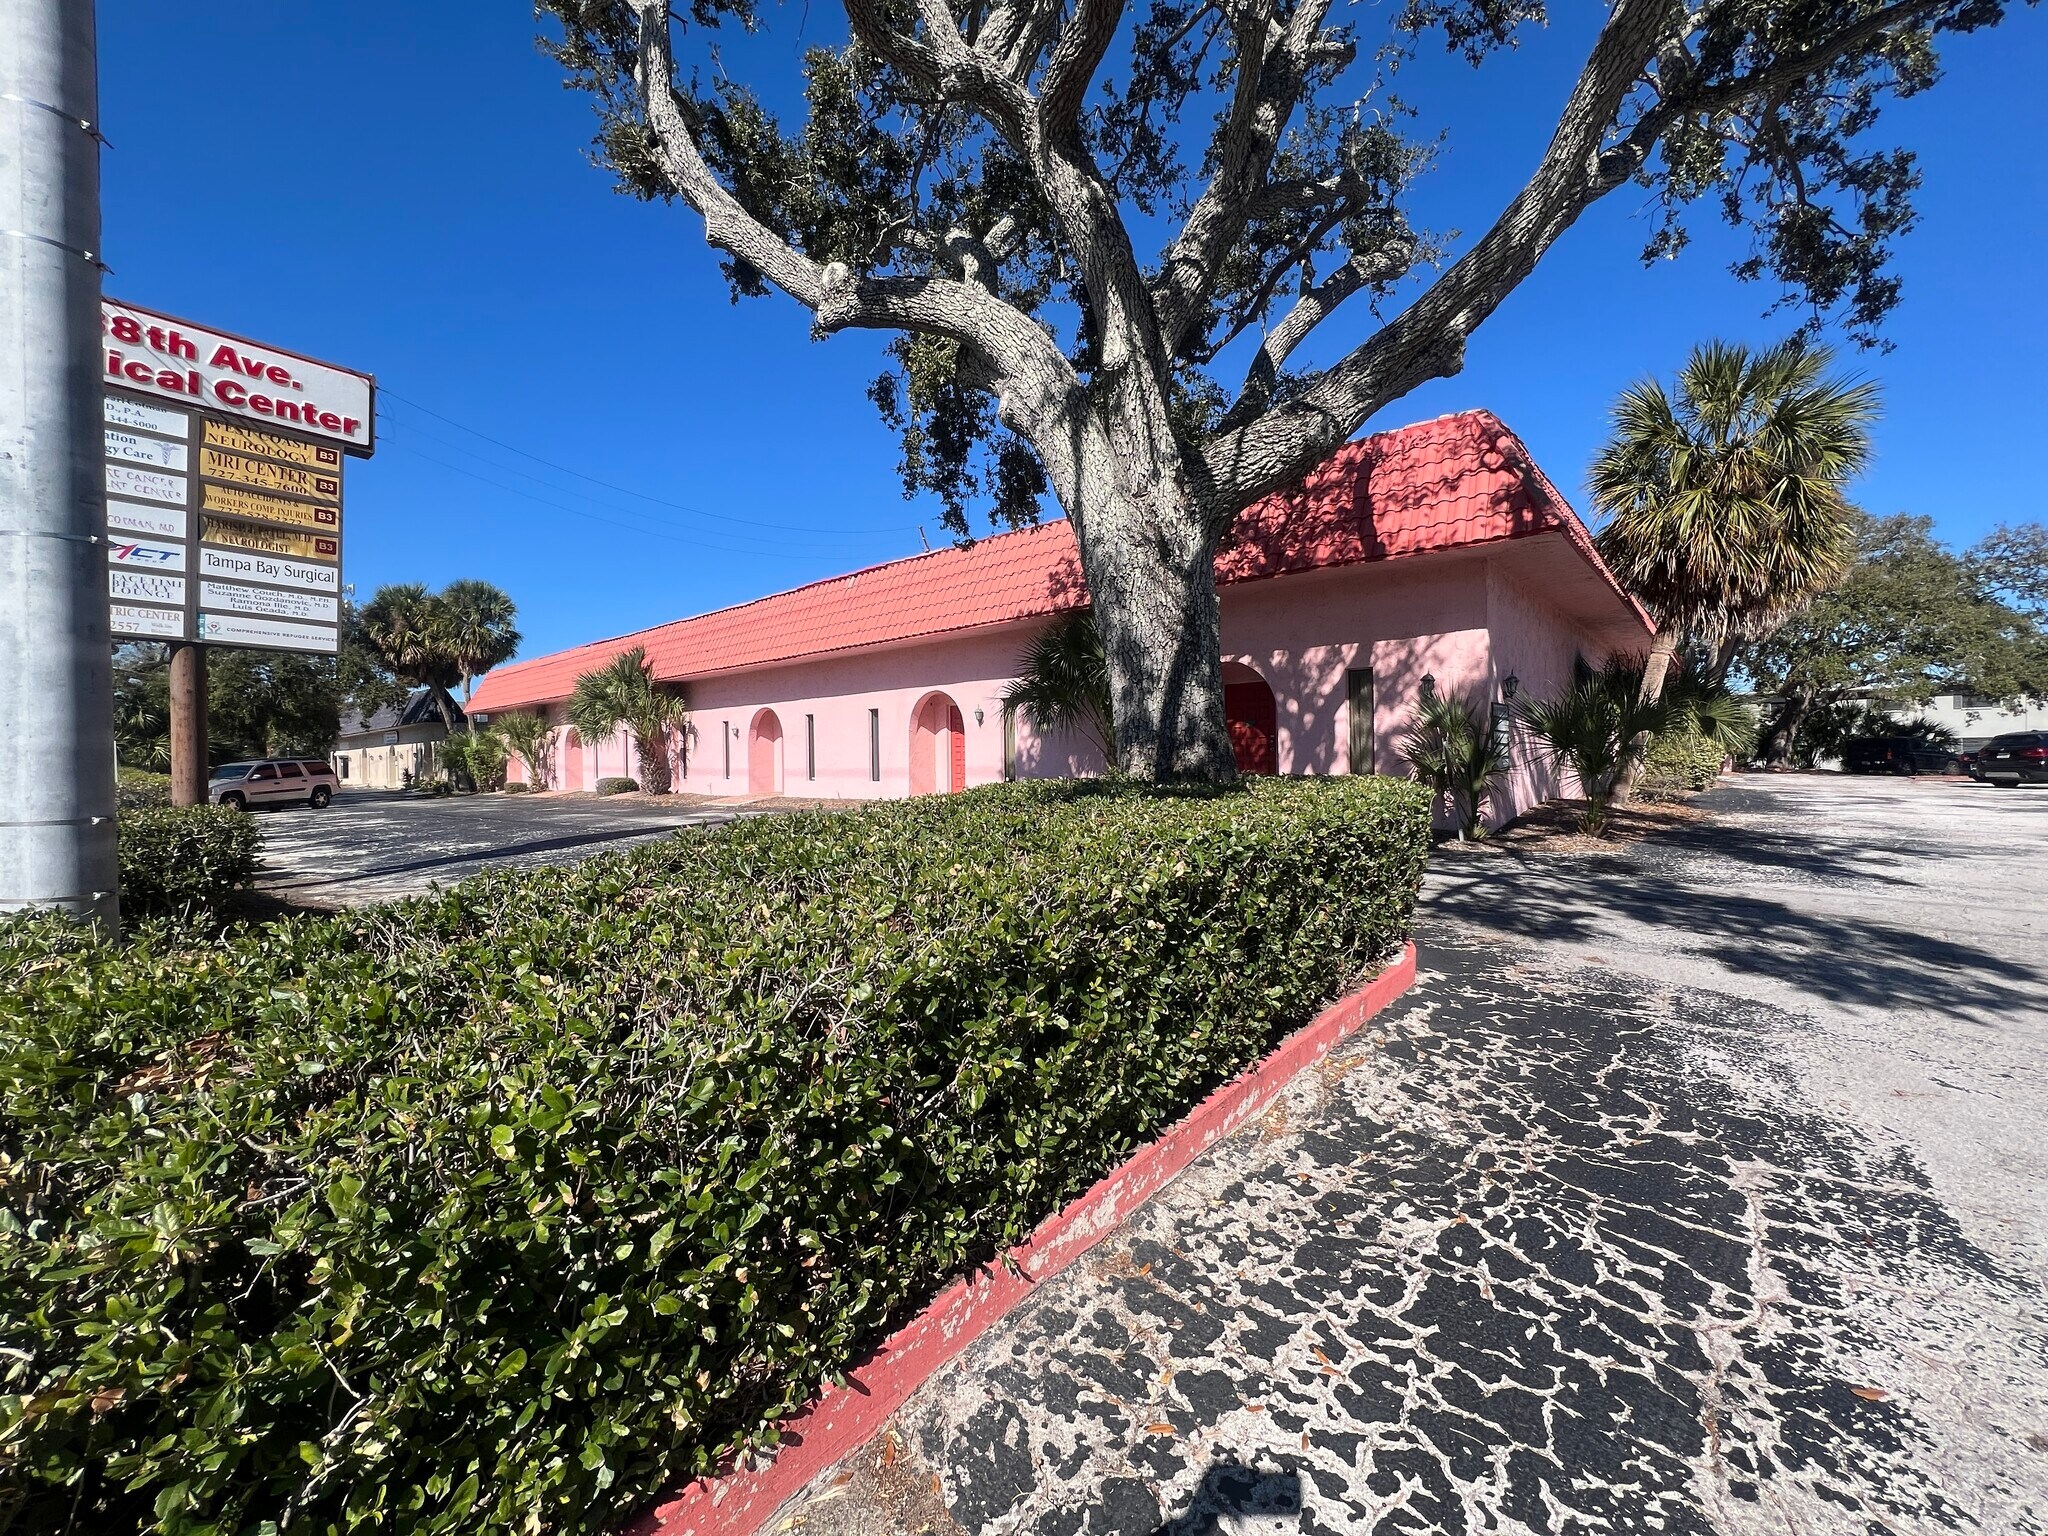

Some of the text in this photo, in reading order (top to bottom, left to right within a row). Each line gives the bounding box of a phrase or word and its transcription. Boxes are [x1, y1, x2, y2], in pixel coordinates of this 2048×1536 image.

[209, 344, 301, 388] Ave.
[108, 349, 359, 433] ical Center
[124, 407, 144, 417] P.A.
[109, 415, 157, 430] 344-5000
[207, 420, 309, 450] WEST COAST
[123, 447, 153, 460] Care
[208, 433, 310, 463] NEUROLOGY
[320, 452, 334, 461] B3
[208, 452, 308, 485] MRI CENTER
[319, 482, 334, 491] B3
[222, 487, 244, 498] AUTO
[246, 492, 291, 506] ACCIDENTS
[206, 495, 248, 509] WORKERS
[277, 508, 313, 520] INJURIES
[319, 512, 333, 521] B3
[221, 534, 289, 553] NEUROLOGIST
[319, 542, 333, 551] B3
[205, 553, 334, 583] Tampa Bay Surgical
[113, 574, 184, 587] FACETIME
[113, 580, 168, 592] BEAUTY
[113, 586, 174, 599] LOUNGE
[207, 583, 249, 593] Matthew
[208, 589, 251, 599] Suzanne
[230, 597, 271, 608] Ramona
[233, 603, 252, 611] Luis
[138, 609, 180, 621] CENTER
[226, 627, 280, 637] COMPREHENSIVE
